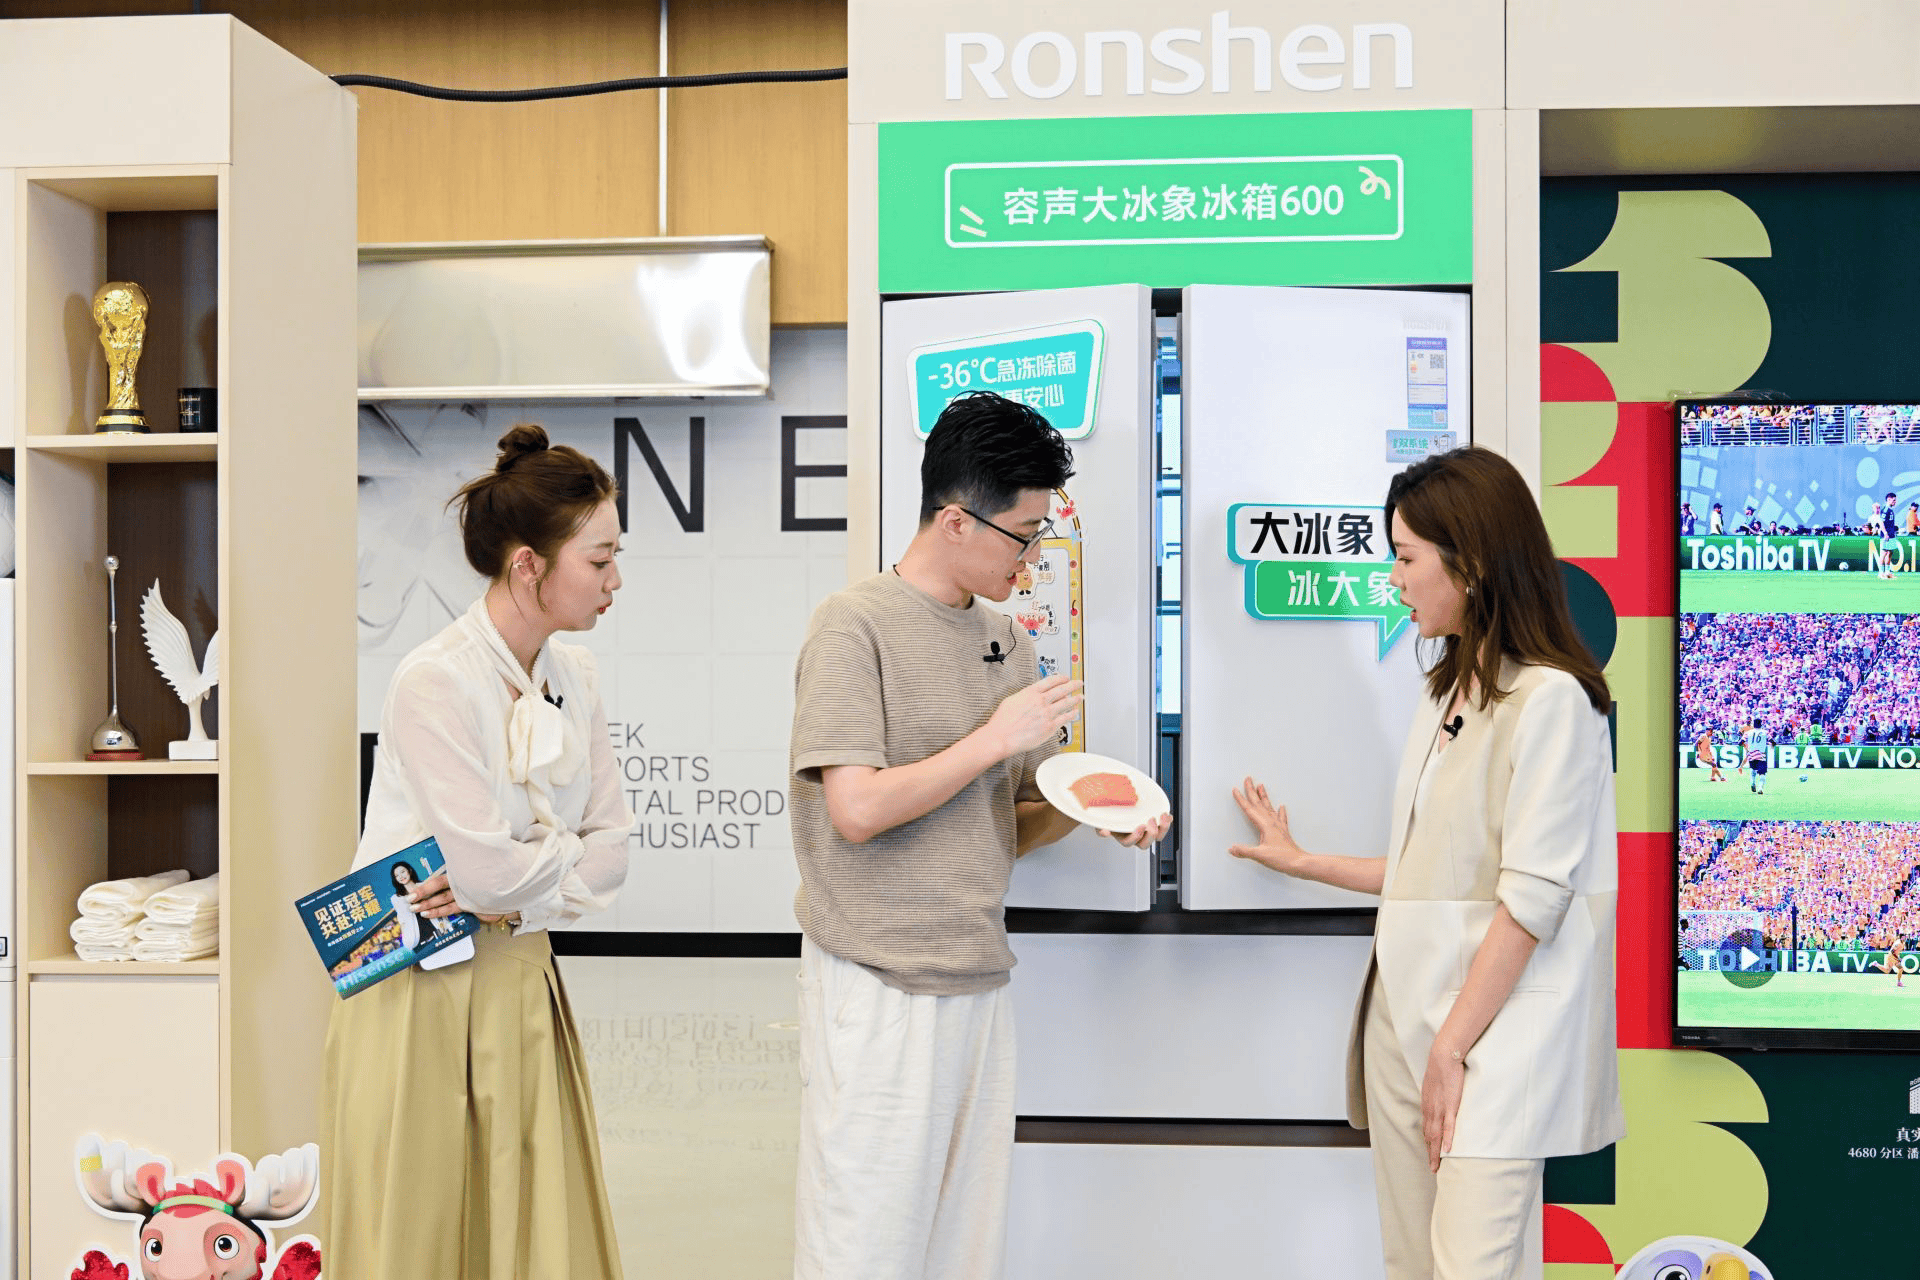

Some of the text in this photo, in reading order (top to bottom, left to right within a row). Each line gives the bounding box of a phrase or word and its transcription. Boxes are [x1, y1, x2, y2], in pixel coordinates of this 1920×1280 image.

[945, 10, 1413, 100] Ronshen
[1003, 183, 1344, 226] 容声大冰象冰箱600
[1250, 511, 1374, 555] 大冰象
[1687, 537, 1794, 570] Toshiba
[1799, 539, 1830, 571] TV
[1288, 570, 1399, 607] 冰大象
[617, 756, 710, 782] ORTS
[1679, 745, 1822, 768] TOSIBA
[1830, 747, 1862, 768] TV
[626, 790, 784, 815] TAL PROD
[314, 884, 376, 926] 见证冠军
[320, 898, 382, 940] 共赴荣耀
[1698, 950, 1832, 973] TOHIBA
[1839, 952, 1869, 973] TV
[1848, 1147, 1877, 1158] 4680
[1880, 1147, 1904, 1159] 分区
